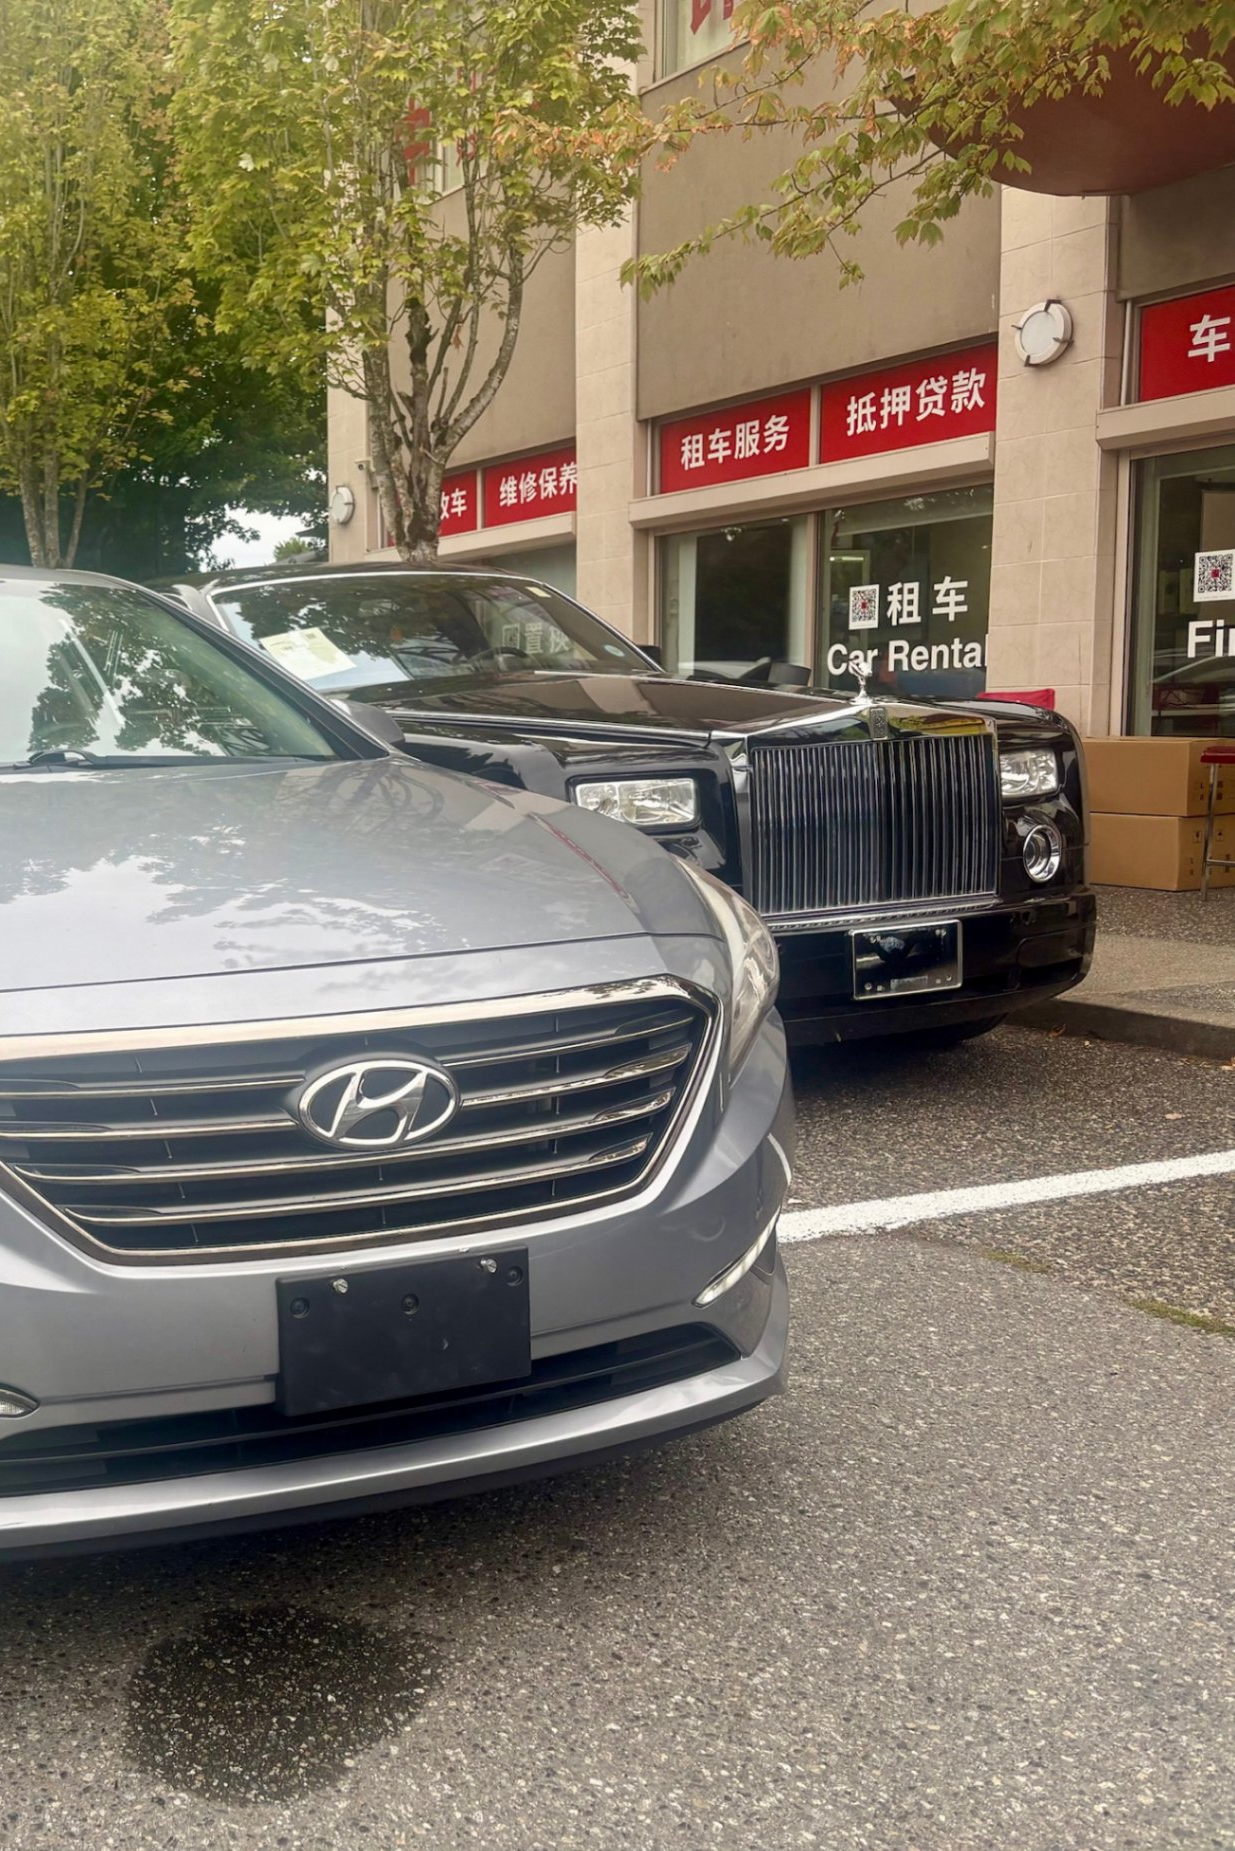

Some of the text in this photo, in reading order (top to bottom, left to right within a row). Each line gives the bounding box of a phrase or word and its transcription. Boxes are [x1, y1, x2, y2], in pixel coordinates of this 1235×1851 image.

[1188, 314, 1231, 362] 车
[846, 367, 986, 437] 抵押贷款
[681, 414, 790, 471] 租车服务
[499, 461, 577, 507] 维修保养
[887, 576, 968, 626] 租车
[827, 643, 878, 676] Car
[1187, 619, 1235, 658] Fi
